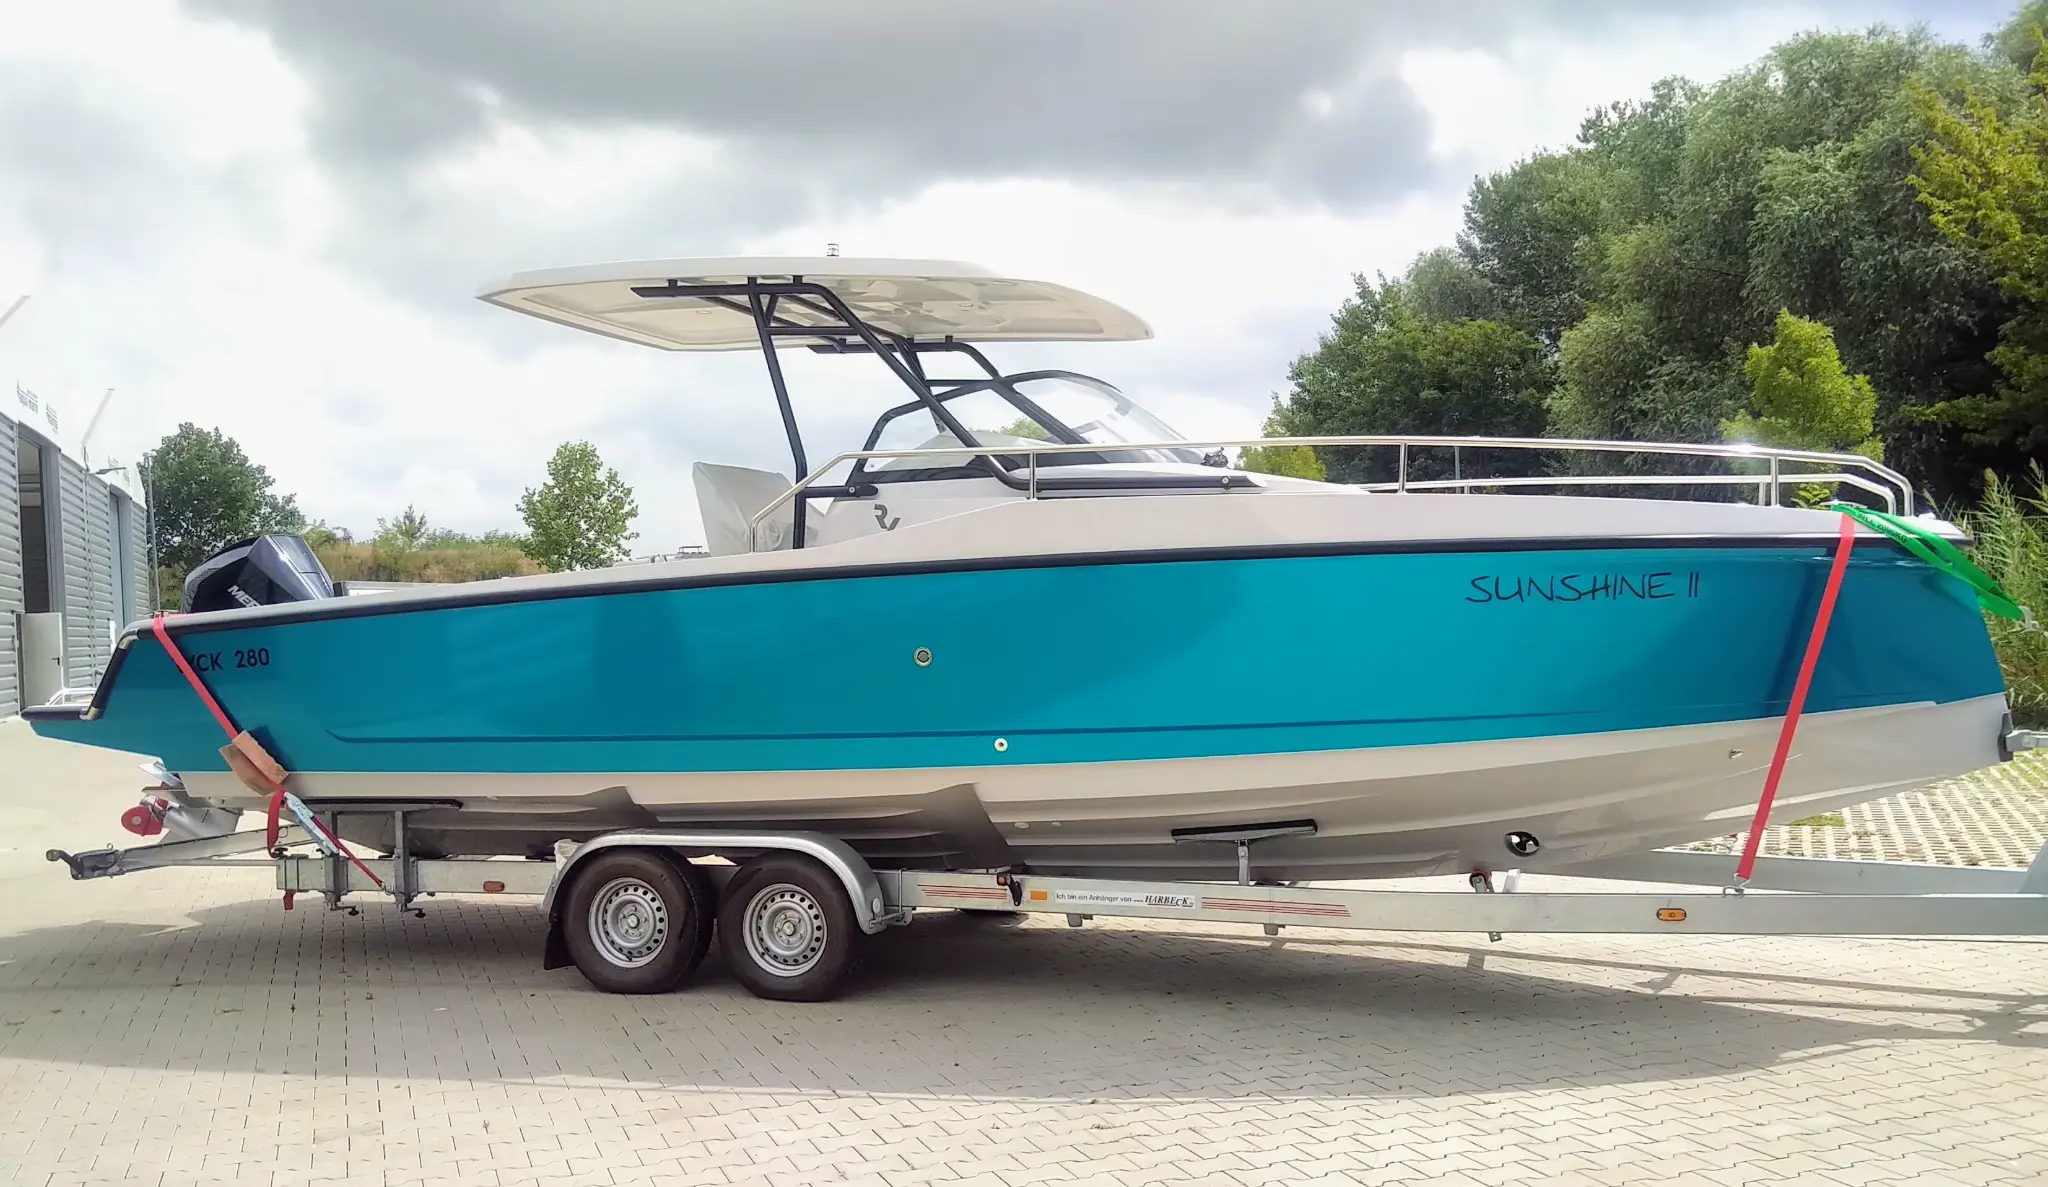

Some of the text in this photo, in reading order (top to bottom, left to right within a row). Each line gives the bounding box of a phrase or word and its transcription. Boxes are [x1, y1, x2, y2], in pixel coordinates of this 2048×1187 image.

[1465, 572, 1675, 602] SUNSHINE
[234, 648, 270, 669] 280
[1089, 894, 1119, 903] Anhänger
